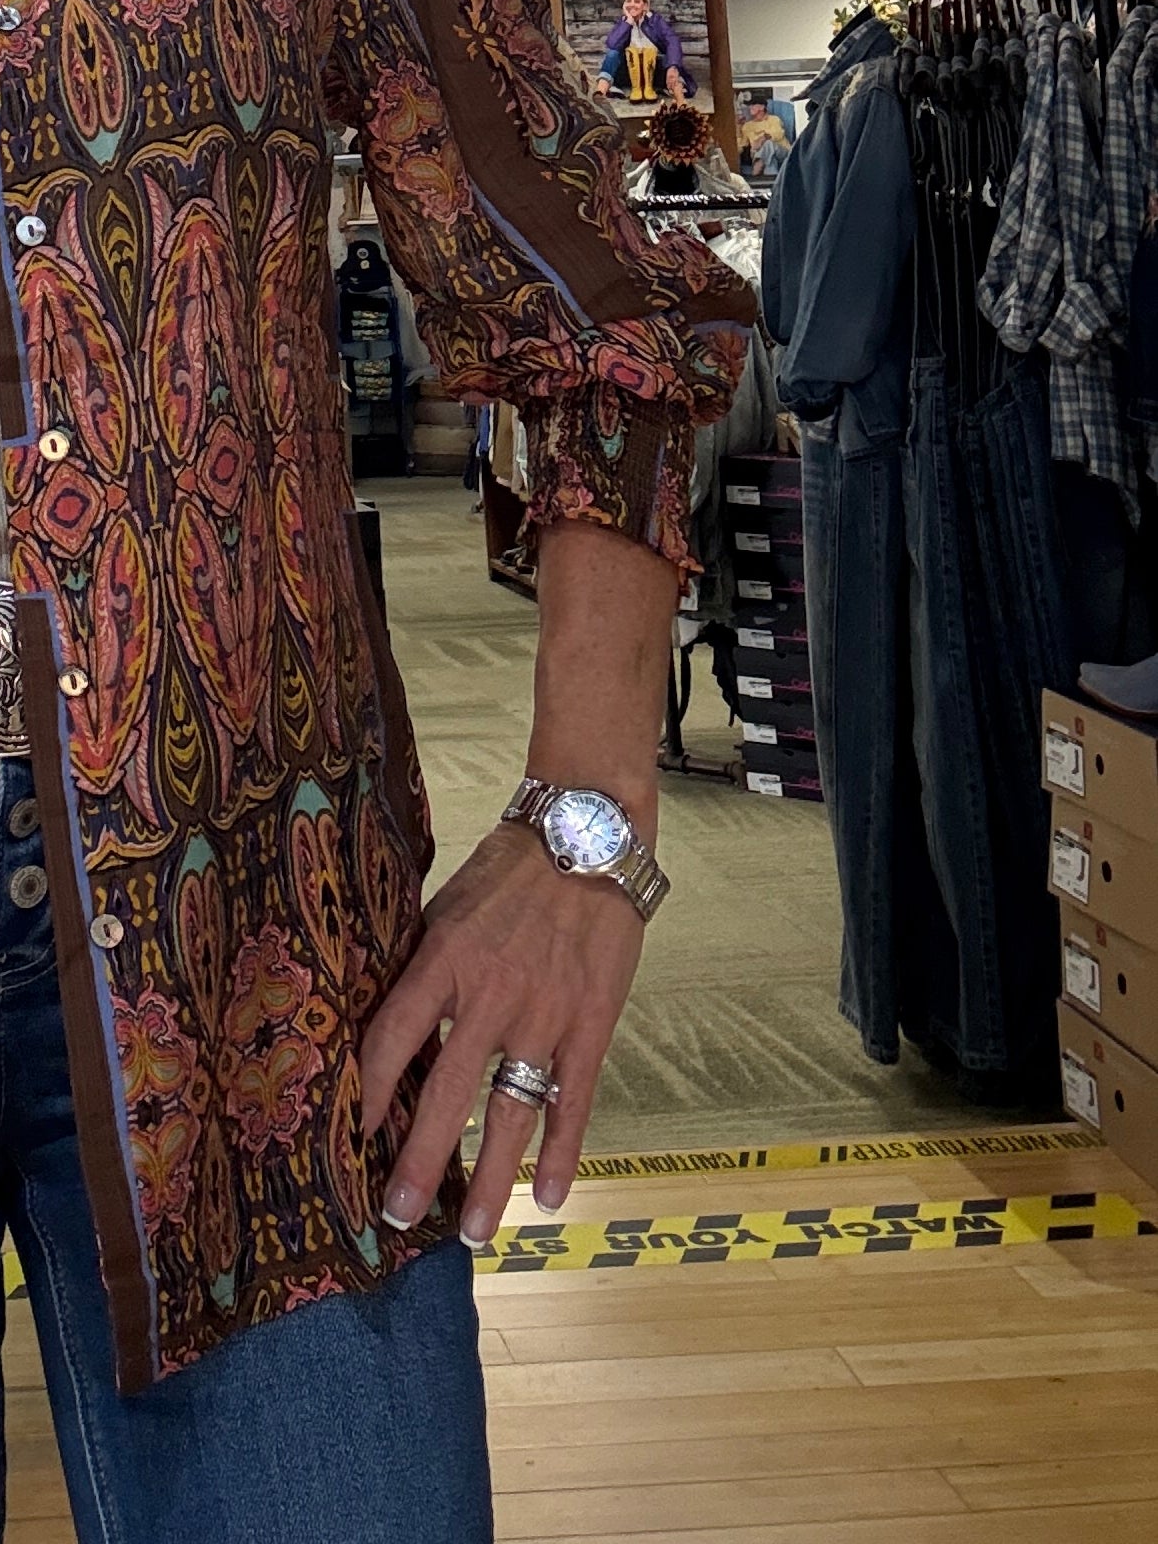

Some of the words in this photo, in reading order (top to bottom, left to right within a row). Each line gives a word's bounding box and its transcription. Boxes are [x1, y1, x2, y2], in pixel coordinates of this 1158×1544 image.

[852, 1142, 911, 1161] STEP
[908, 1138, 972, 1158] YOUR
[971, 1133, 1058, 1155] WATCH
[640, 1151, 737, 1175] CAUTION
[799, 1214, 1007, 1241] WATCH
[473, 1238, 571, 1259] STE
[603, 1230, 770, 1252] YOUR
